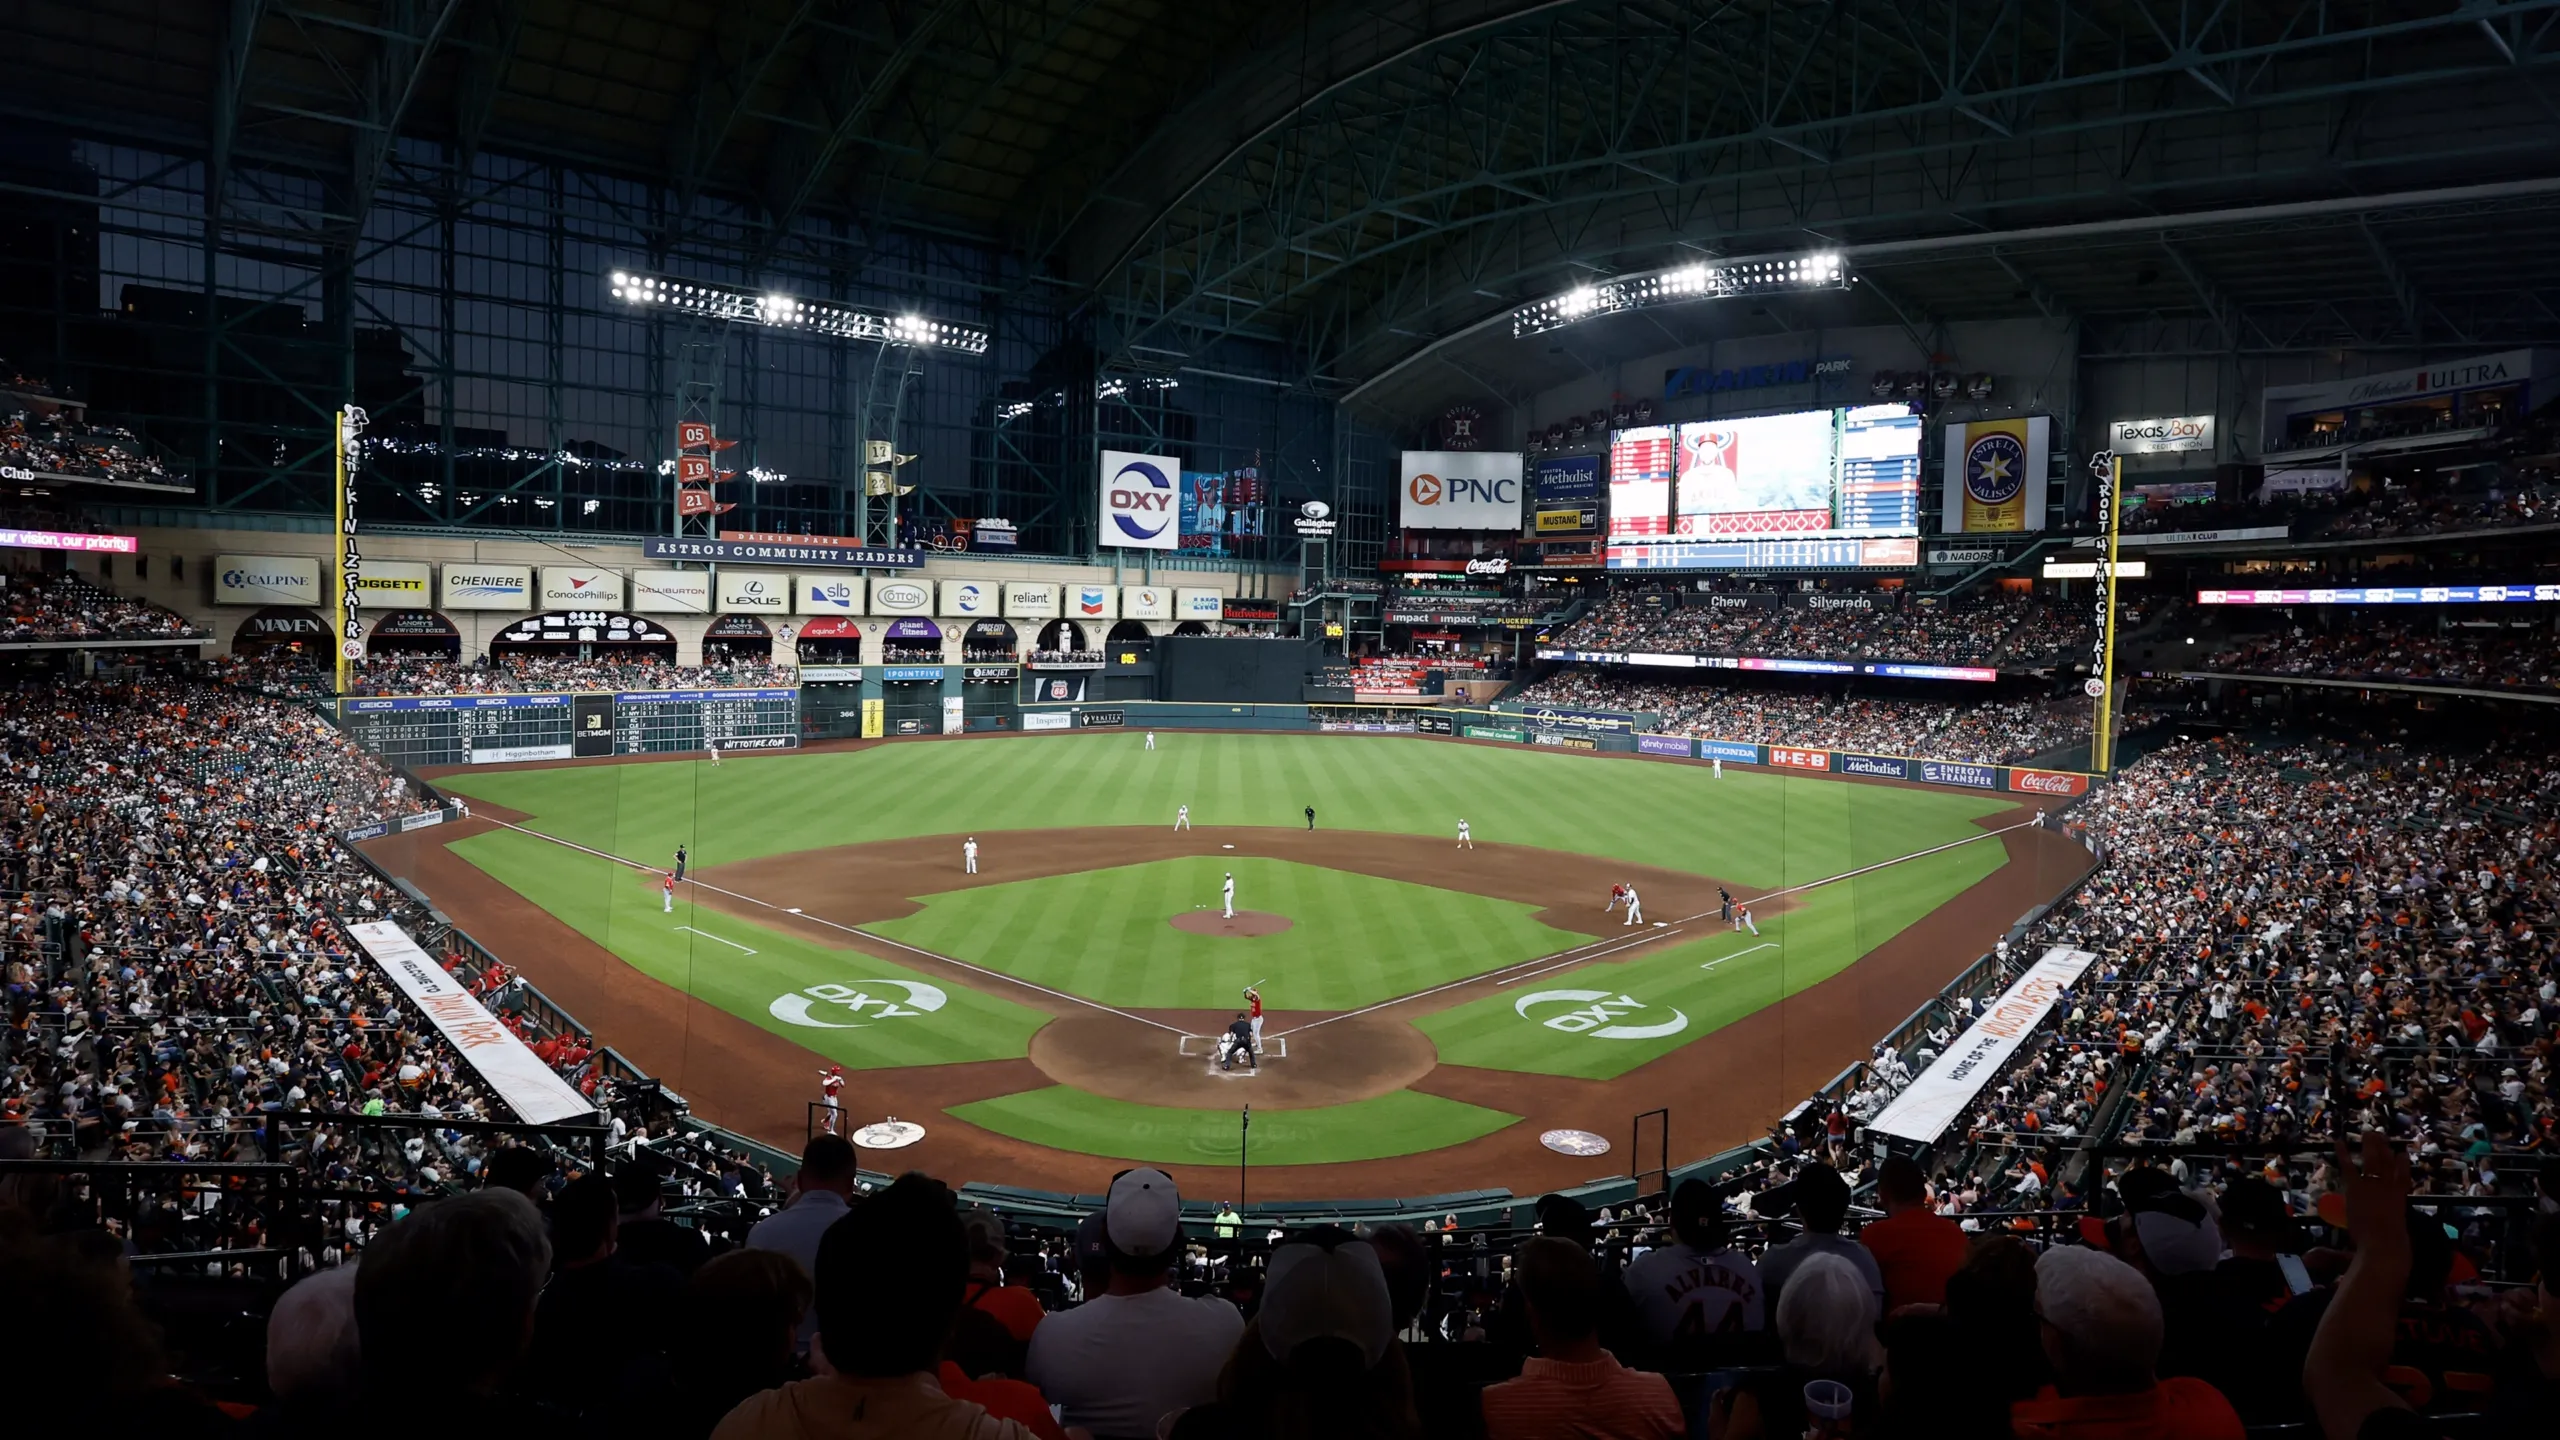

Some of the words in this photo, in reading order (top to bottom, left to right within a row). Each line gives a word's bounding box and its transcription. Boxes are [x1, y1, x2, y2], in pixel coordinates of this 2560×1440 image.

[1816, 359, 1851, 375] PARK
[2433, 362, 2509, 388] ULTRA
[686, 428, 705, 442] 05
[2117, 425, 2164, 440] Texas
[2172, 419, 2207, 439] Bay
[1971, 439, 2022, 462] ESTRELLA
[2147, 441, 2173, 450] CREDIT
[2175, 439, 2203, 449] UNION
[872, 446, 886, 458] 17
[1, 467, 35, 482] Club
[687, 463, 705, 475] 19
[872, 478, 886, 489] 22
[1540, 469, 1594, 486] Methodist
[1446, 479, 1516, 504] PNC
[1972, 482, 2018, 499] JALISCO
[686, 495, 703, 507] 21
[1109, 489, 1172, 511] OXY
[1294, 517, 1336, 529] Gallagher
[1544, 515, 1577, 525] MUSTANG
[1581, 513, 1594, 524] CAT
[19, 532, 61, 548] vision,
[62, 535, 85, 547] our
[86, 536, 129, 551] priority
[738, 533, 793, 542] DAIKIN
[804, 536, 840, 545] PARK
[2166, 534, 2192, 542] ULTRA
[2198, 532, 2218, 541] CLUB
[656, 542, 725, 556] ASTROS
[733, 546, 839, 560] COMMUNITY
[846, 551, 915, 563] LEADERS
[1950, 551, 1994, 561] NABORS
[1465, 558, 1507, 574] Coca-Cola
[247, 573, 309, 586] CALPINE
[356, 579, 422, 590] OGGETT
[451, 576, 523, 587] CHENIERE
[547, 590, 618, 601] ConocoPhillips
[638, 587, 705, 595] HALLIBURTON
[827, 584, 850, 598] slb
[884, 590, 920, 604] COTTON
[1013, 590, 1048, 604] reliant
[726, 597, 782, 605] LEXUS
[959, 594, 980, 602] OXY
[1193, 598, 1218, 610] LNG
[1711, 596, 1747, 609] Chevy
[1809, 595, 1871, 609] Silverado
[1224, 608, 1278, 619] Budweiser
[1393, 614, 1429, 625] impact
[1440, 614, 1477, 625] impact
[255, 619, 320, 633] MAVEN
[899, 621, 924, 630] planet
[976, 623, 994, 632] SPACE
[994, 623, 1006, 632] CITY
[812, 628, 835, 636] equinor
[902, 628, 928, 636] fitness
[1382, 658, 1420, 667] Budweiser
[1441, 660, 1475, 668] Budweiser
[888, 669, 941, 678] 1POINTFIVE
[981, 668, 1010, 678] EMCJET
[1886, 666, 1901, 675] visit
[1054, 687, 1064, 695] 66
[419, 699, 452, 707] GEICO
[1036, 716, 1067, 726] Insperity
[577, 729, 611, 738] BETMGM
[1475, 730, 1494, 738] National
[1535, 734, 1552, 744] SPACE
[1552, 736, 1563, 745] CITY
[724, 739, 785, 749] NITTOTIRE.COM
[1641, 739, 1664, 748] xfinity
[1664, 742, 1689, 751] mobile
[505, 749, 556, 759] Higginbotham
[1713, 747, 1756, 757] HONDA
[1847, 760, 1901, 775] Methodist
[1940, 766, 1982, 775] ENERGY
[1941, 773, 1992, 786] TRANSFER
[2021, 773, 2074, 793] Coca-Cola
[346, 825, 383, 841] AmegyBank
[400, 960, 433, 984] WELCOME
[423, 984, 442, 994] TO
[803, 983, 922, 1019] OXY
[1543, 994, 1647, 1032] OXY
[1977, 1004, 2037, 1039] HOUSTON
[446, 1021, 507, 1049] PARK
[1947, 1062, 1973, 1081] HOME
[1968, 1050, 1985, 1062] OF
[1979, 1037, 1999, 1051] THE
[1665, 1266, 1756, 1304] ALVAREZ
[1673, 1300, 1744, 1336] 44
